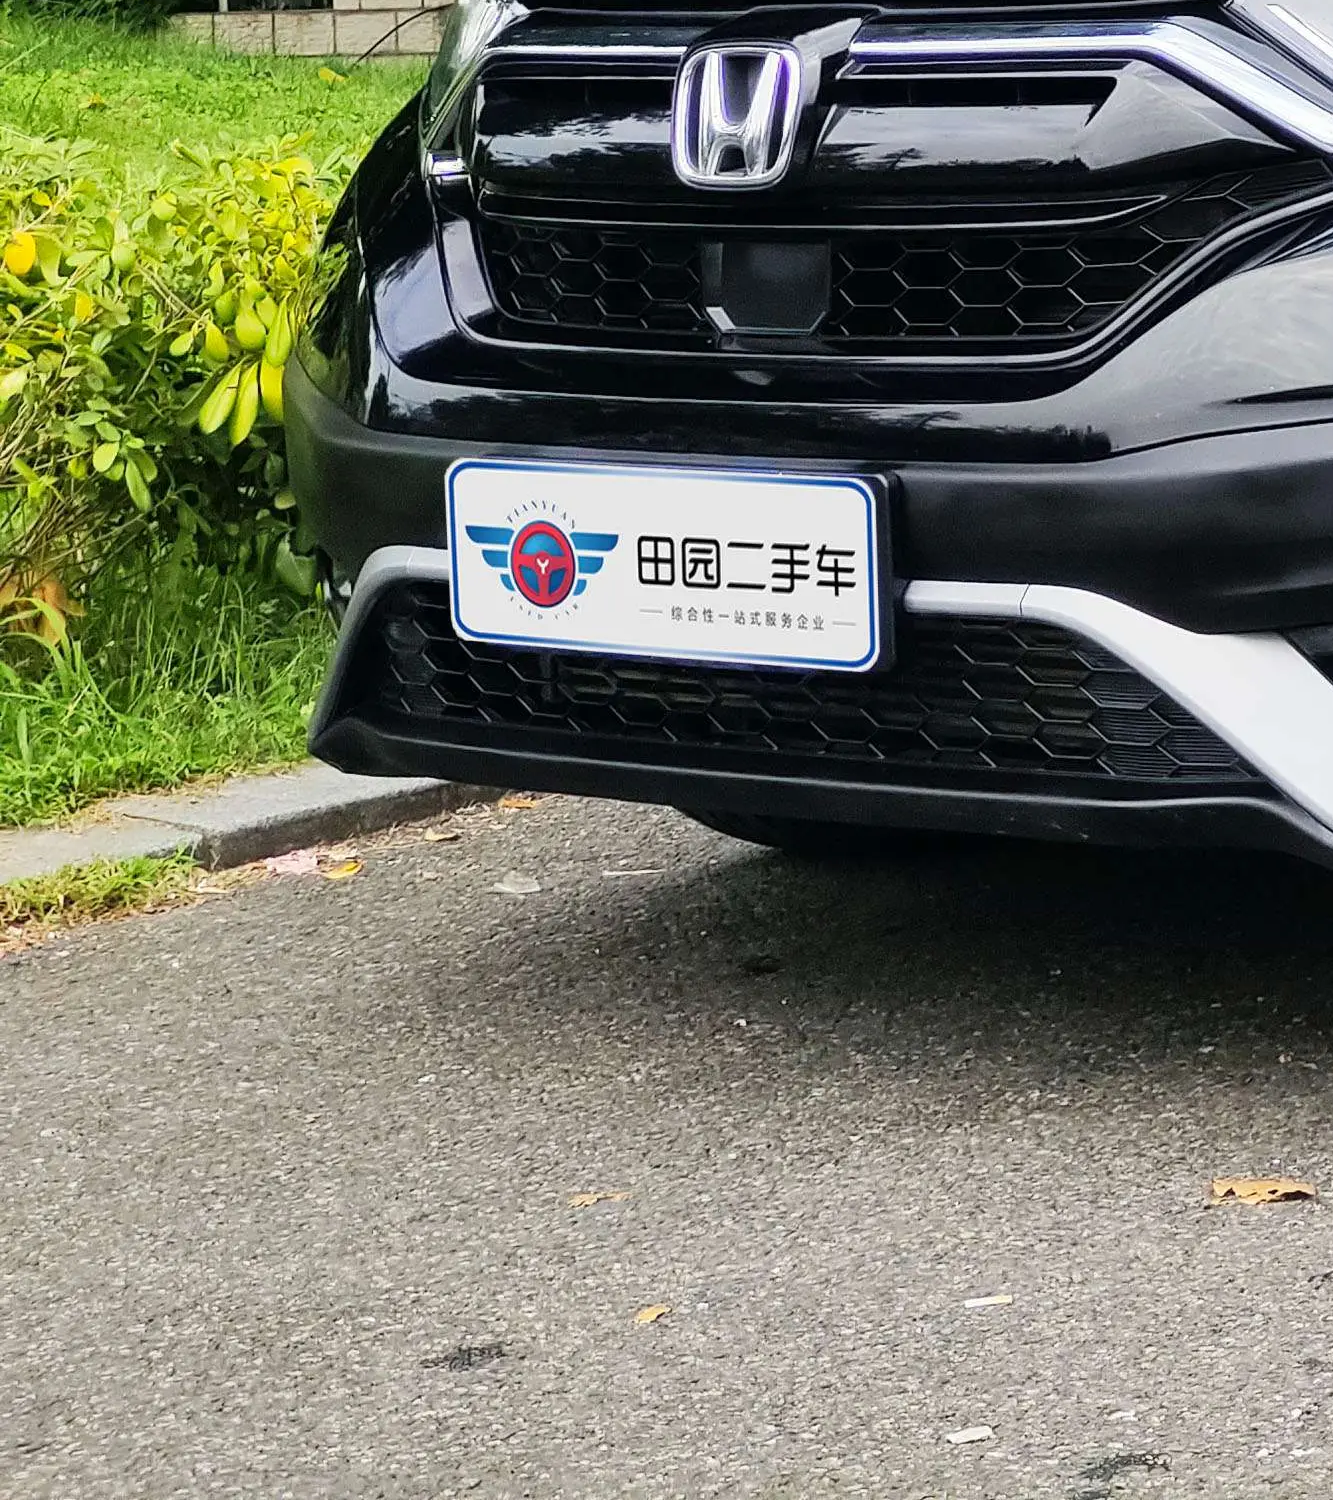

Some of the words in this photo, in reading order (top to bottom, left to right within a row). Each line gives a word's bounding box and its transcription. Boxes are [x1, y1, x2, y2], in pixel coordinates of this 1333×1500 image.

[637, 535, 857, 597] 田园二手车
[670, 604, 825, 631] 综合性一站式服务企业
